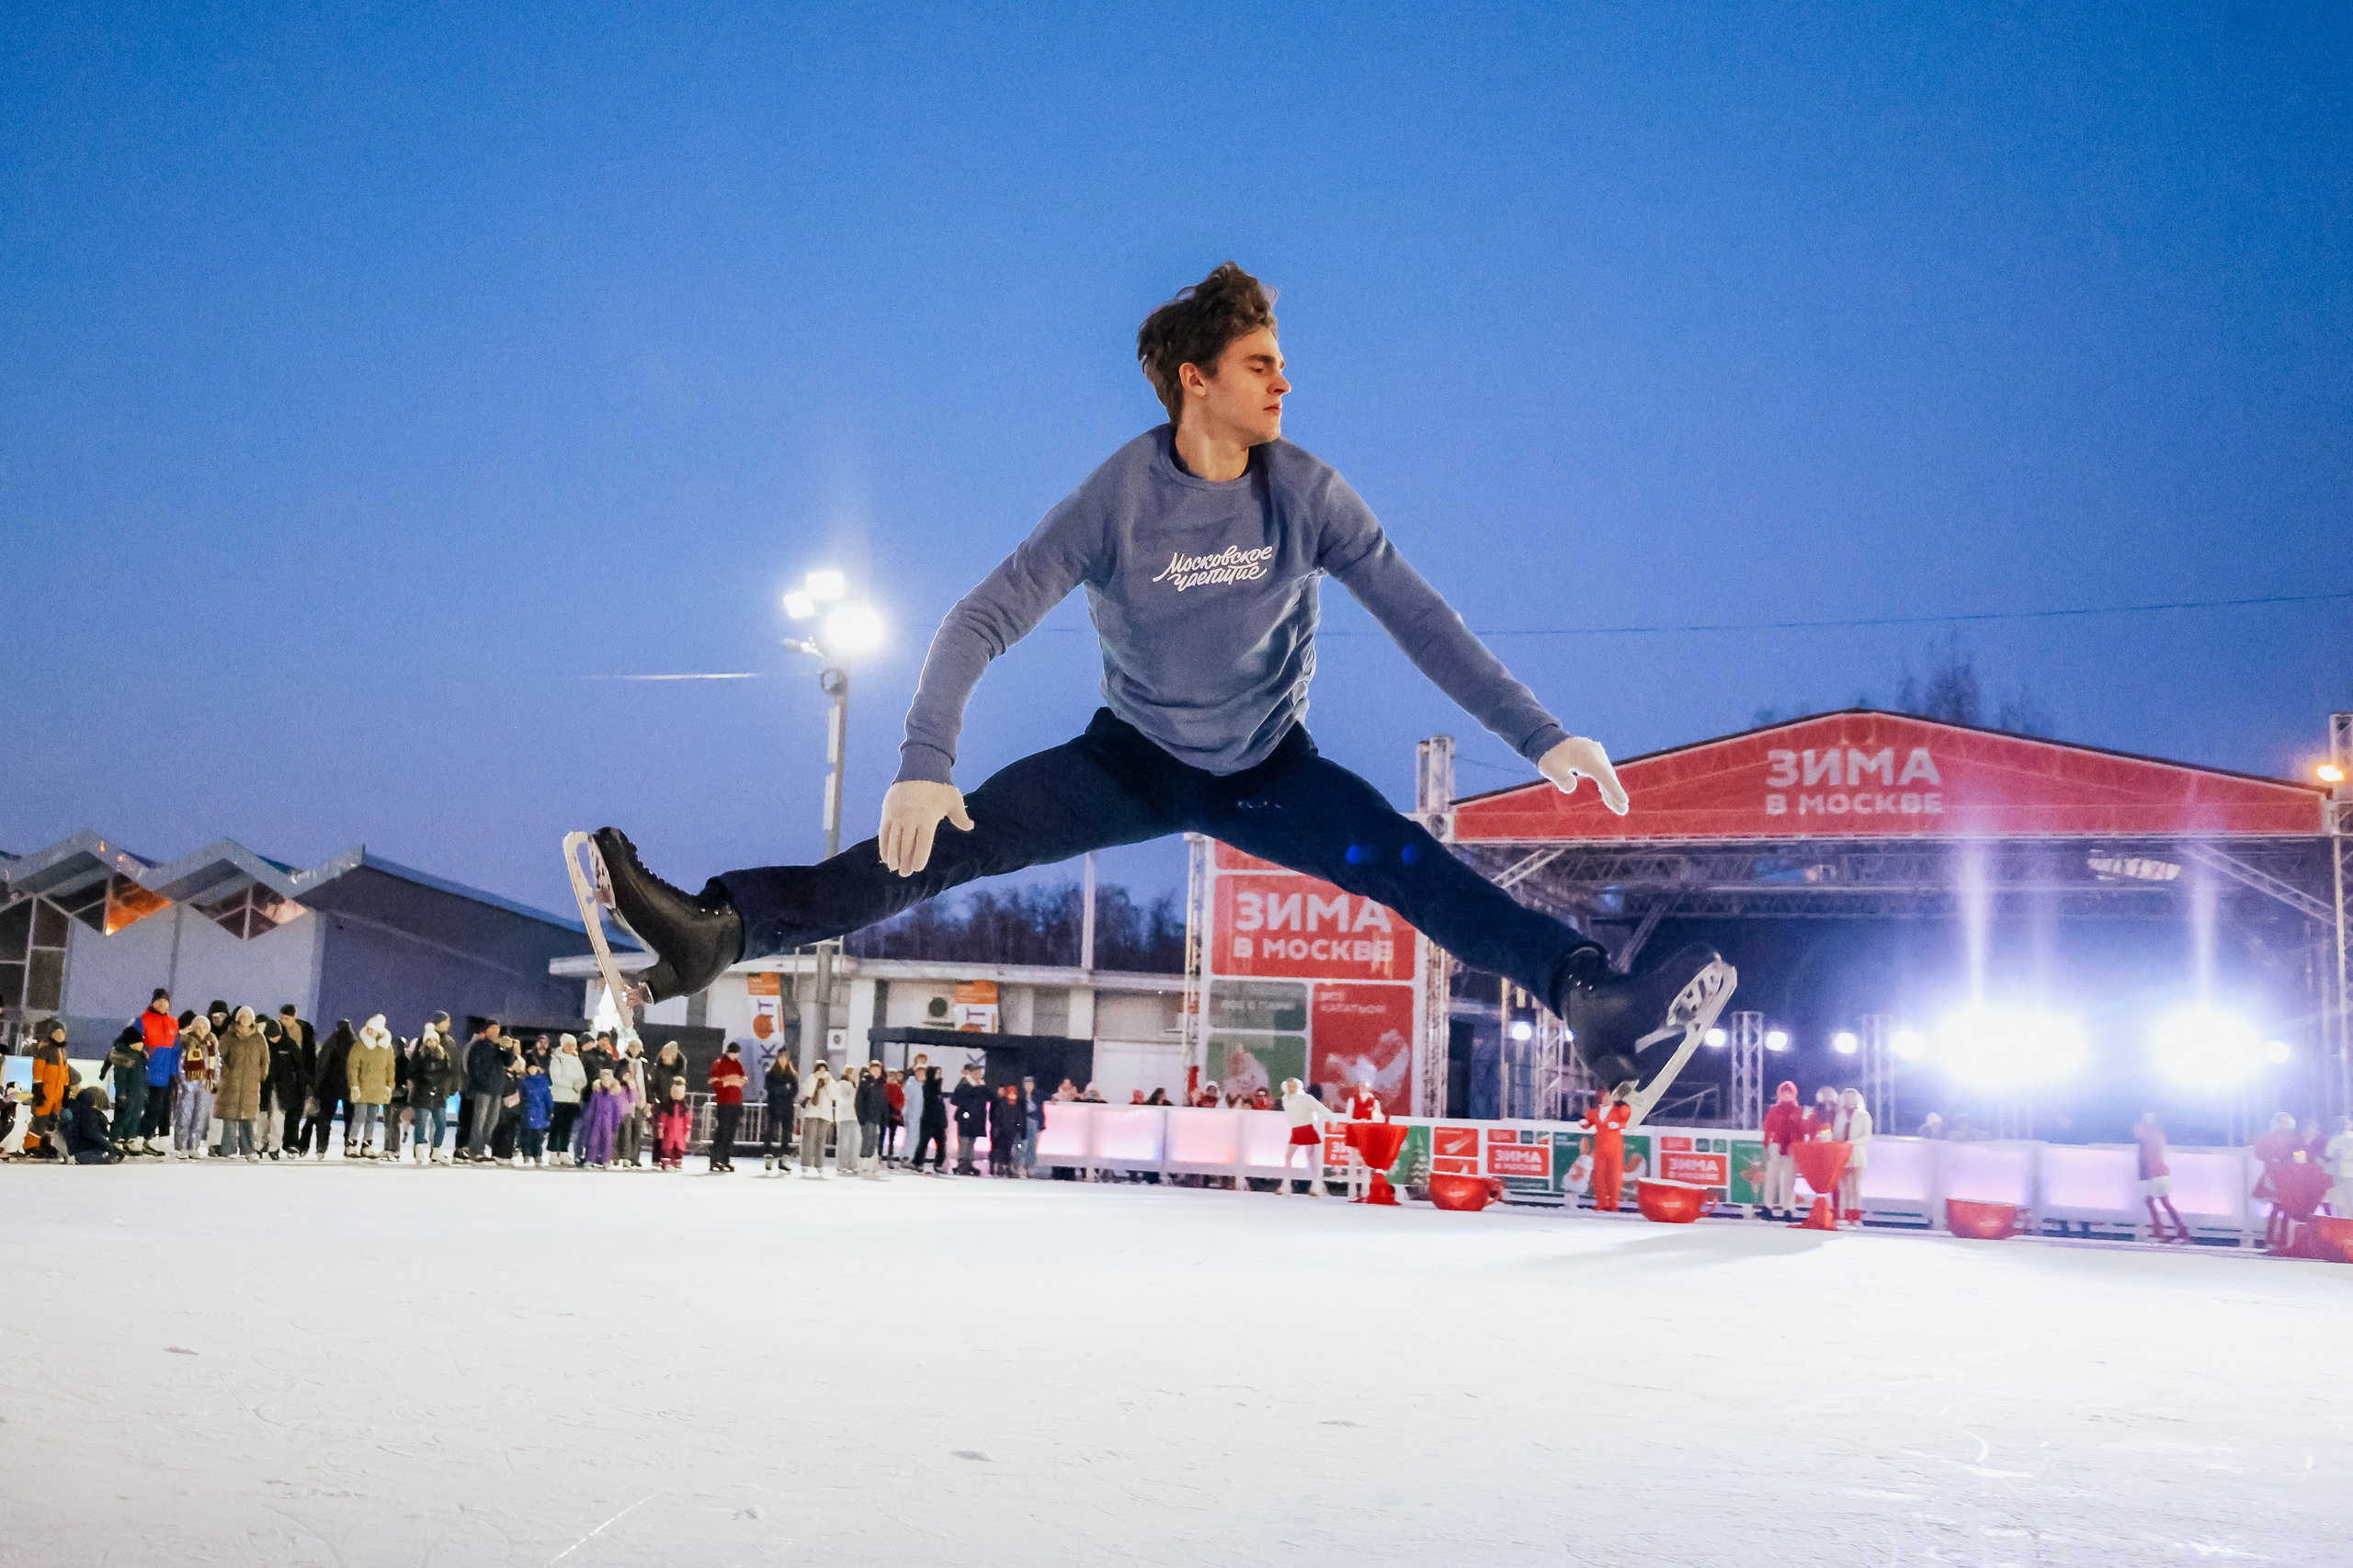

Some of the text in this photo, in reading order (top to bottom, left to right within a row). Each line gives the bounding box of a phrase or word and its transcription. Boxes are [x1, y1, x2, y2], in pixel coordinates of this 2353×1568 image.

[1153, 545, 1273, 582] Московское
[1766, 746, 1943, 788] ЗИМА
[1766, 792, 1945, 815] В МОСКВЕ
[1235, 892, 1392, 933] ЗИМА
[1233, 937, 1393, 962] В МОСКВЕ
[1495, 1149, 1542, 1164] ЗИМА
[1668, 1157, 1719, 1172] ЗИМА
